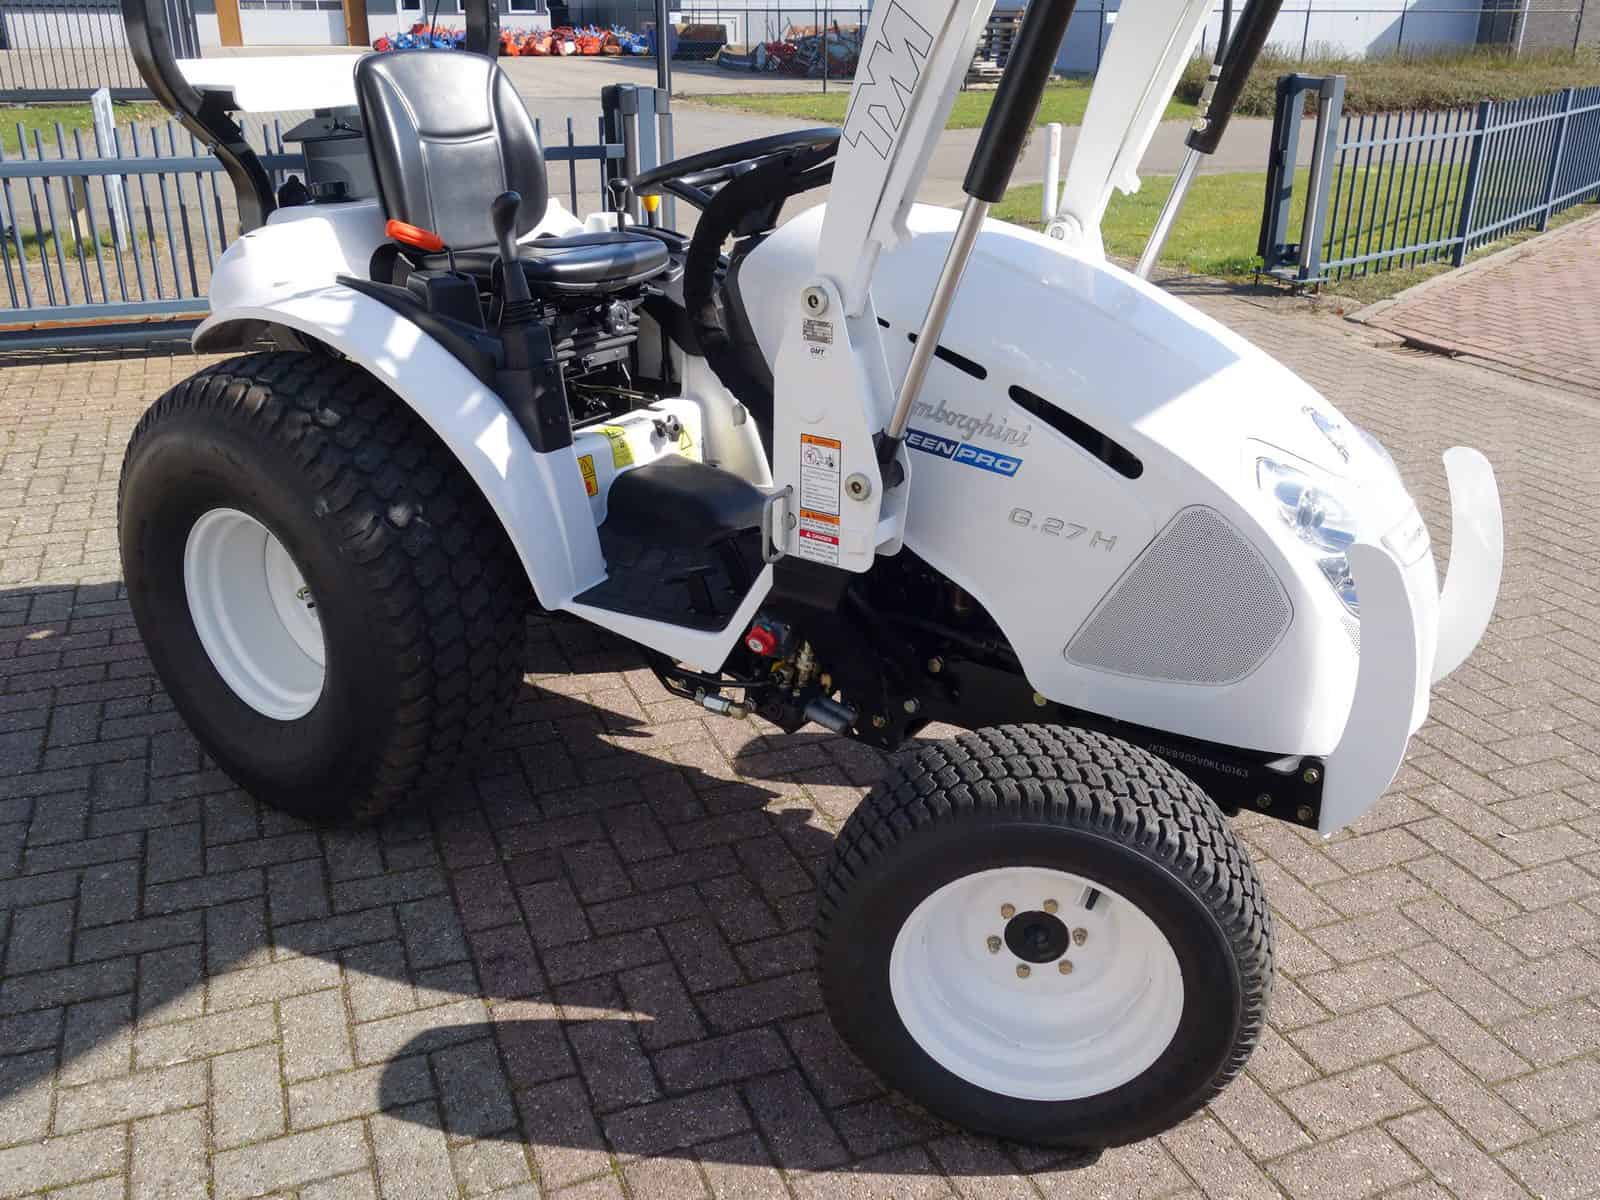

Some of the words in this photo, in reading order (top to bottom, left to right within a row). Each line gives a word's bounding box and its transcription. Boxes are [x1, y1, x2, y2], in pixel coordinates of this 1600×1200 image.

[911, 399, 1032, 448] mborghini
[903, 430, 956, 456] EEN
[957, 447, 1019, 472] PRO
[1088, 530, 1118, 552] H
